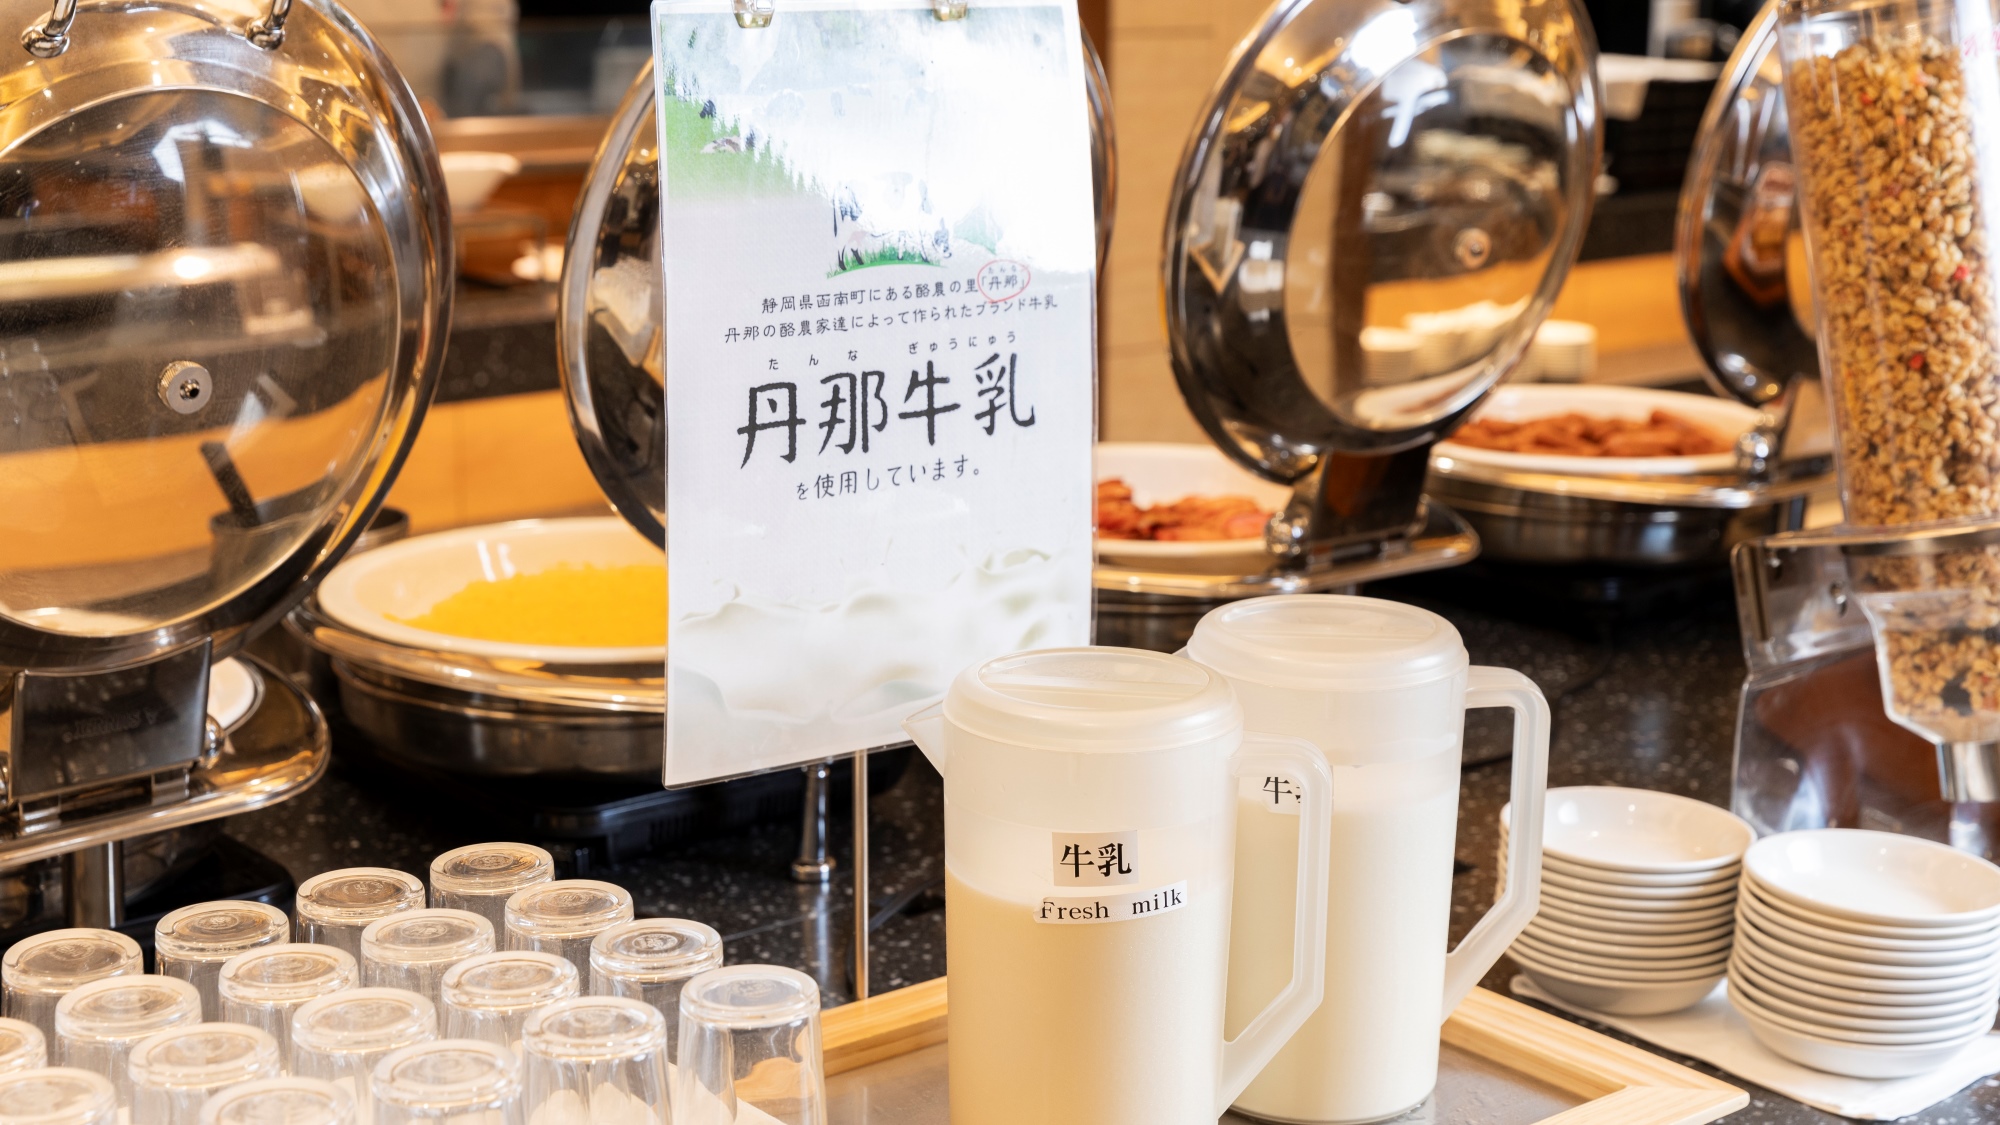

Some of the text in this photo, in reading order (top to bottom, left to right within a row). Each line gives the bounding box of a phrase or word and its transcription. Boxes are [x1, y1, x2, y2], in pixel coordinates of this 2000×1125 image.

[724, 293, 1058, 344] 丹那の酪農家達によって作られたブランド牛乳
[768, 331, 1017, 371] たんな ぎゅうにゅう
[737, 352, 1036, 469] 丹那牛乳
[797, 454, 980, 500] を使用しています。
[1262, 776, 1301, 805] 牛
[1060, 842, 1132, 878] 牛乳
[1039, 888, 1183, 920] Fresh milk
